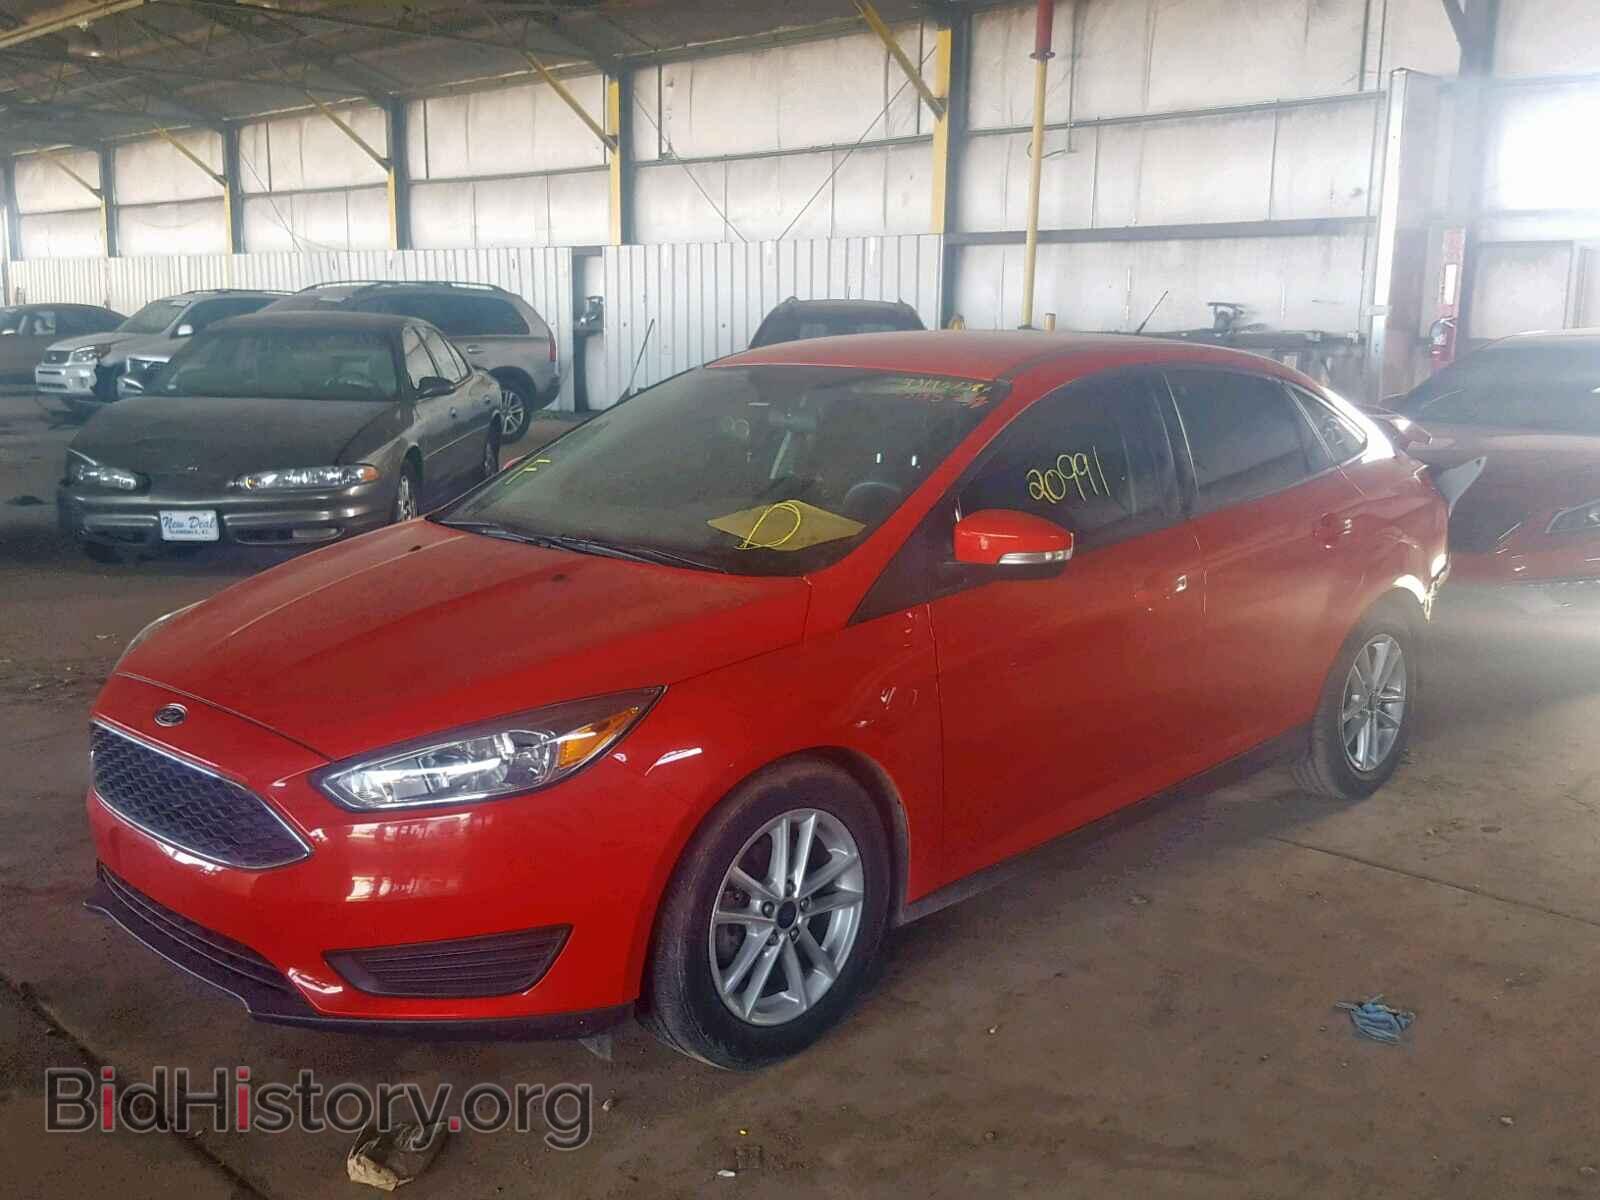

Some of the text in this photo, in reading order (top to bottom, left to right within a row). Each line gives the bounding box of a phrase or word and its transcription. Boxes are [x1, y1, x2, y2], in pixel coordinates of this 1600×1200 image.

[1025, 445, 1111, 504] 20991
[162, 516, 216, 529] New Deal
